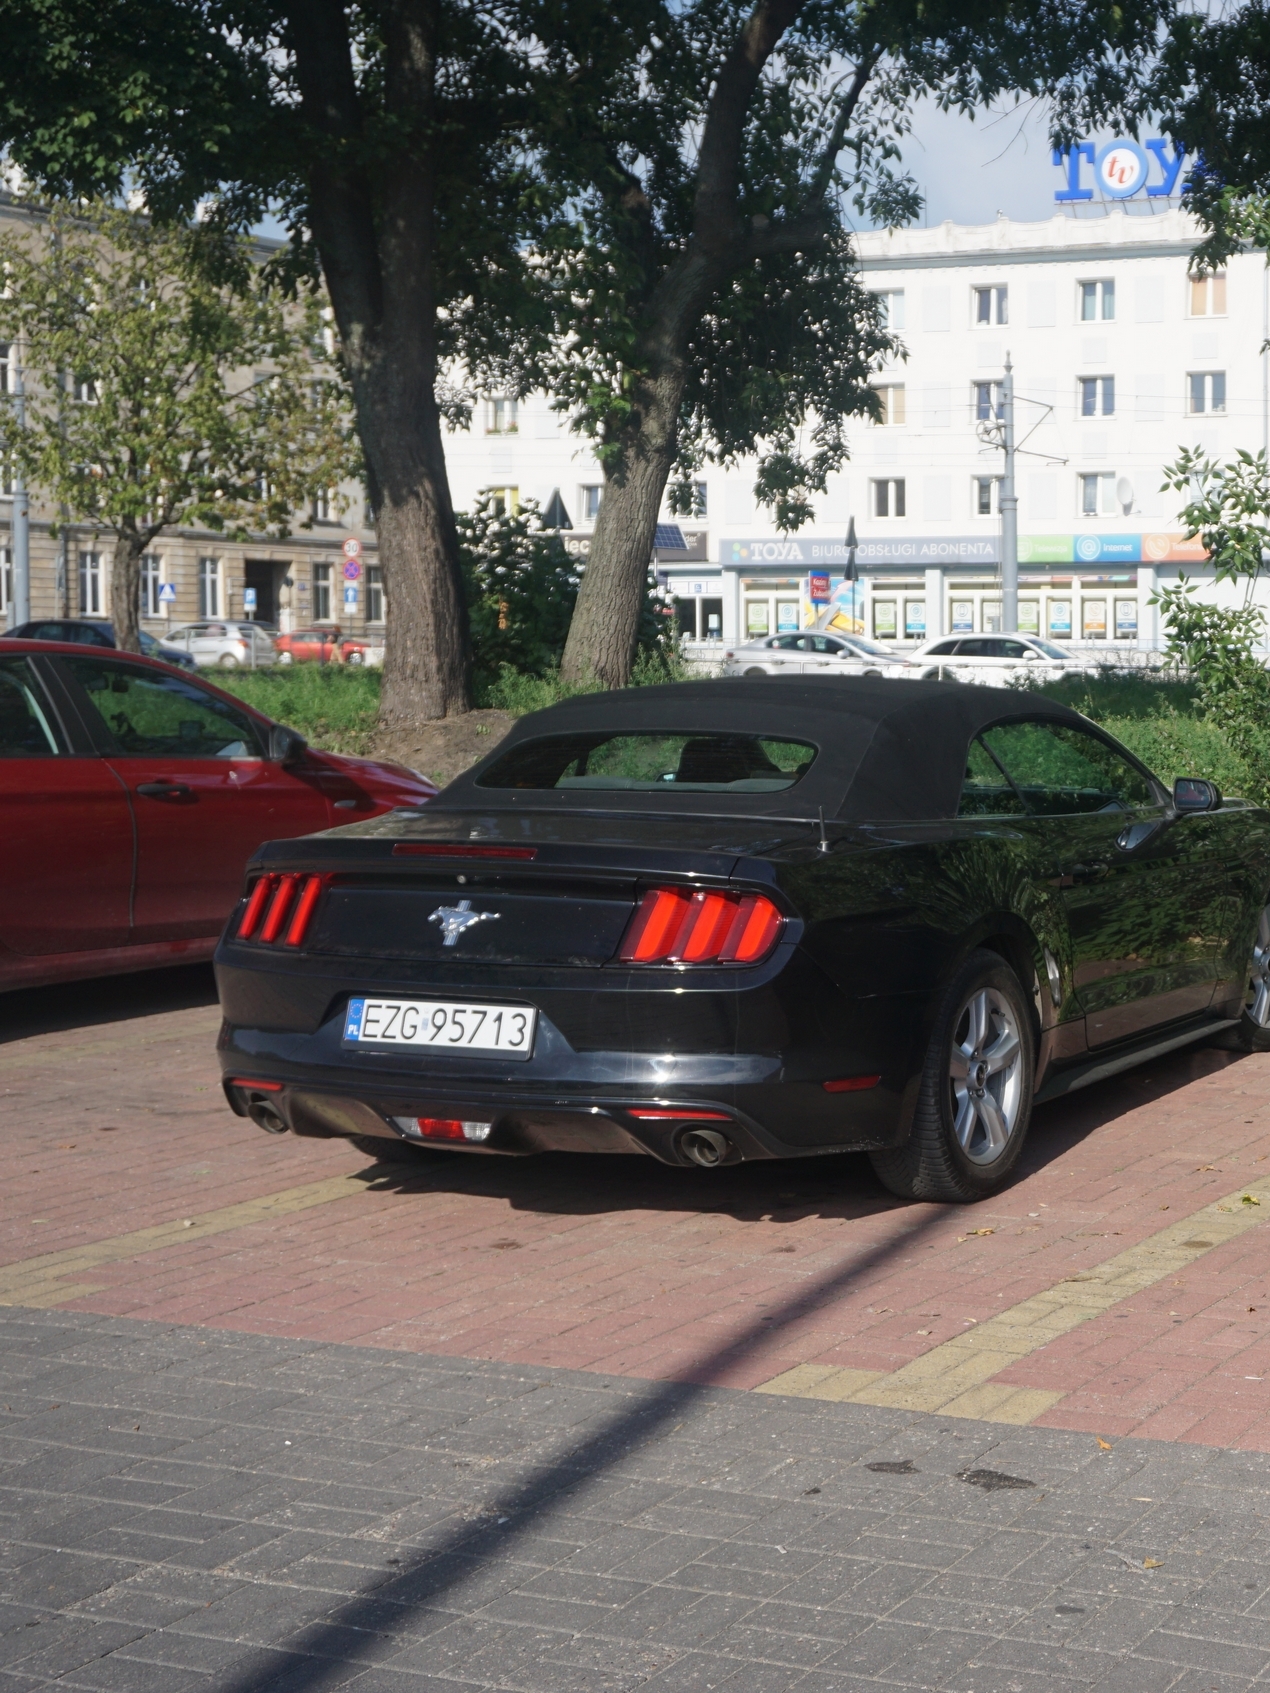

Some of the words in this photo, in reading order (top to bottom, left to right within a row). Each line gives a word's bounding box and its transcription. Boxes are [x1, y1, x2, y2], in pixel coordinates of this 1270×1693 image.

[1107, 155, 1134, 184] tv
[346, 543, 358, 553] 30
[750, 542, 804, 560] TOYA
[856, 544, 916, 556] OBSŁUGI
[920, 543, 994, 555] ABONENTA
[1103, 543, 1133, 552] Internet
[347, 1024, 359, 1035] PL
[362, 1004, 420, 1040] EZG
[428, 1007, 527, 1047] 95713
